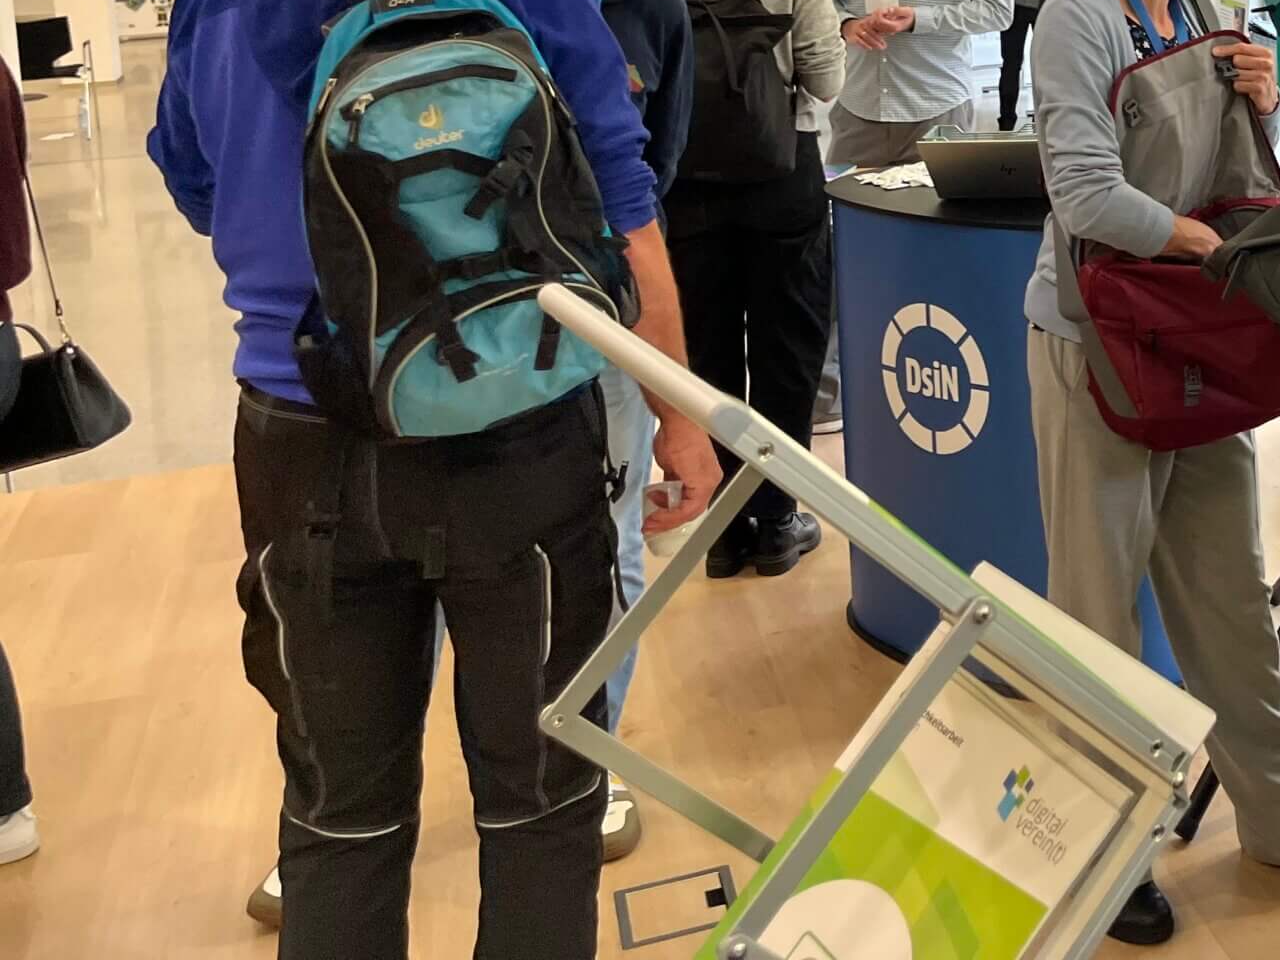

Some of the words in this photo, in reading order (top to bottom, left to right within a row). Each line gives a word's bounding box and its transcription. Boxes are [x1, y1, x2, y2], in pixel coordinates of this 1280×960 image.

[904, 357, 960, 403] DsiN
[1015, 814, 1068, 866] verein(t)
[1025, 797, 1069, 837] digital
